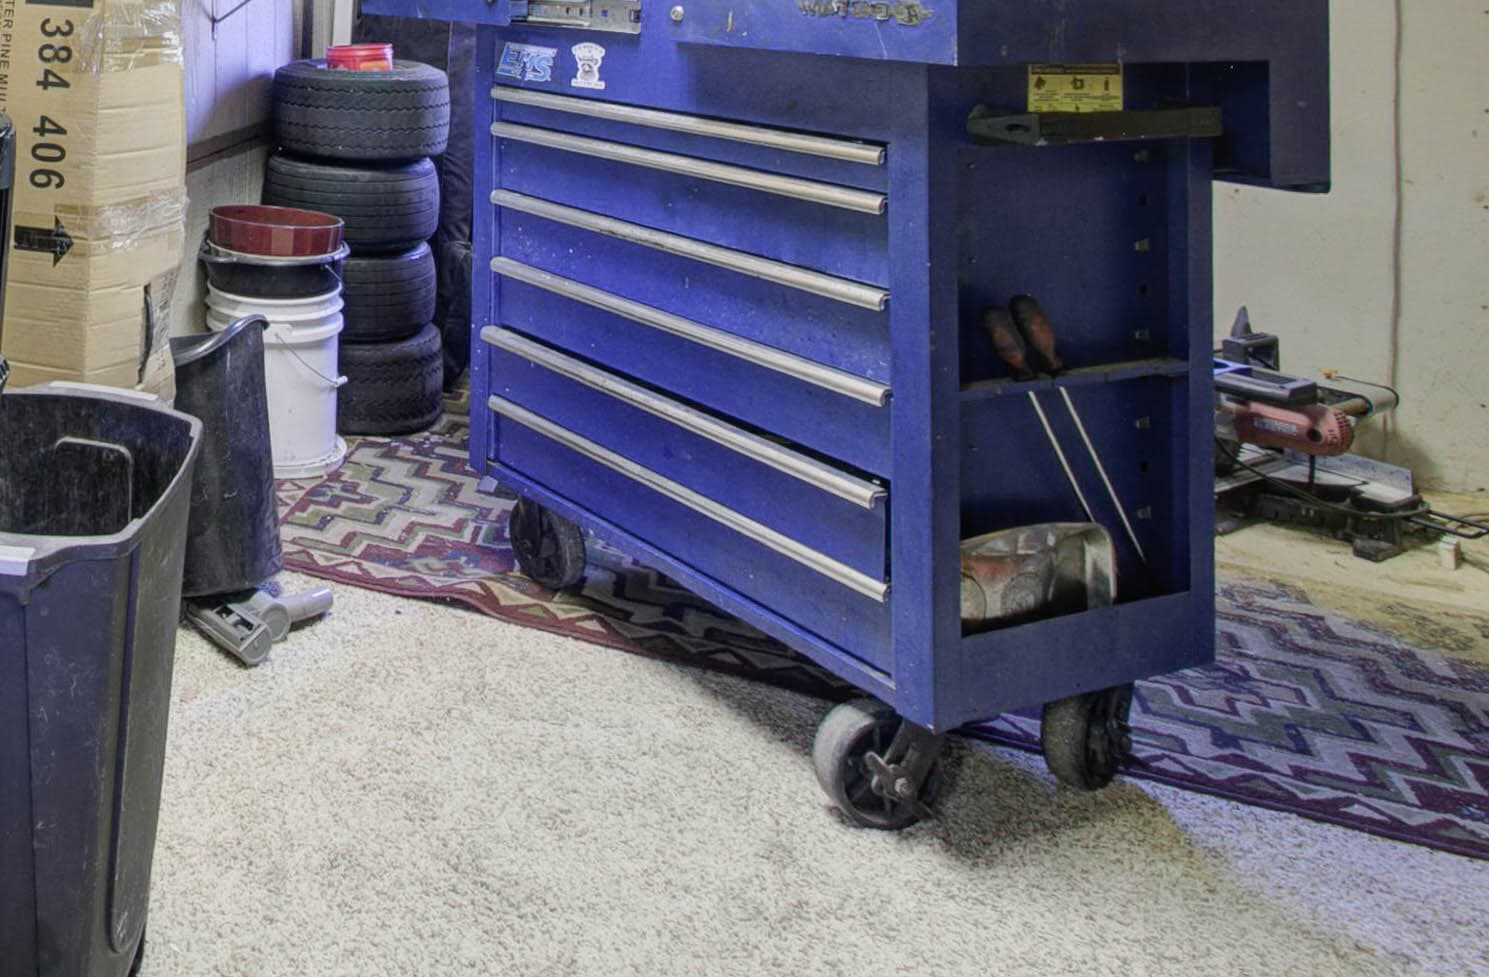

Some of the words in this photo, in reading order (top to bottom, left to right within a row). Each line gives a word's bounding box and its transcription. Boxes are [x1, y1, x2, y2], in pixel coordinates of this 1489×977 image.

[0, 33, 12, 70] PINE
[36, 18, 74, 91] 384
[497, 43, 554, 81] EMS
[30, 115, 67, 189] 406
